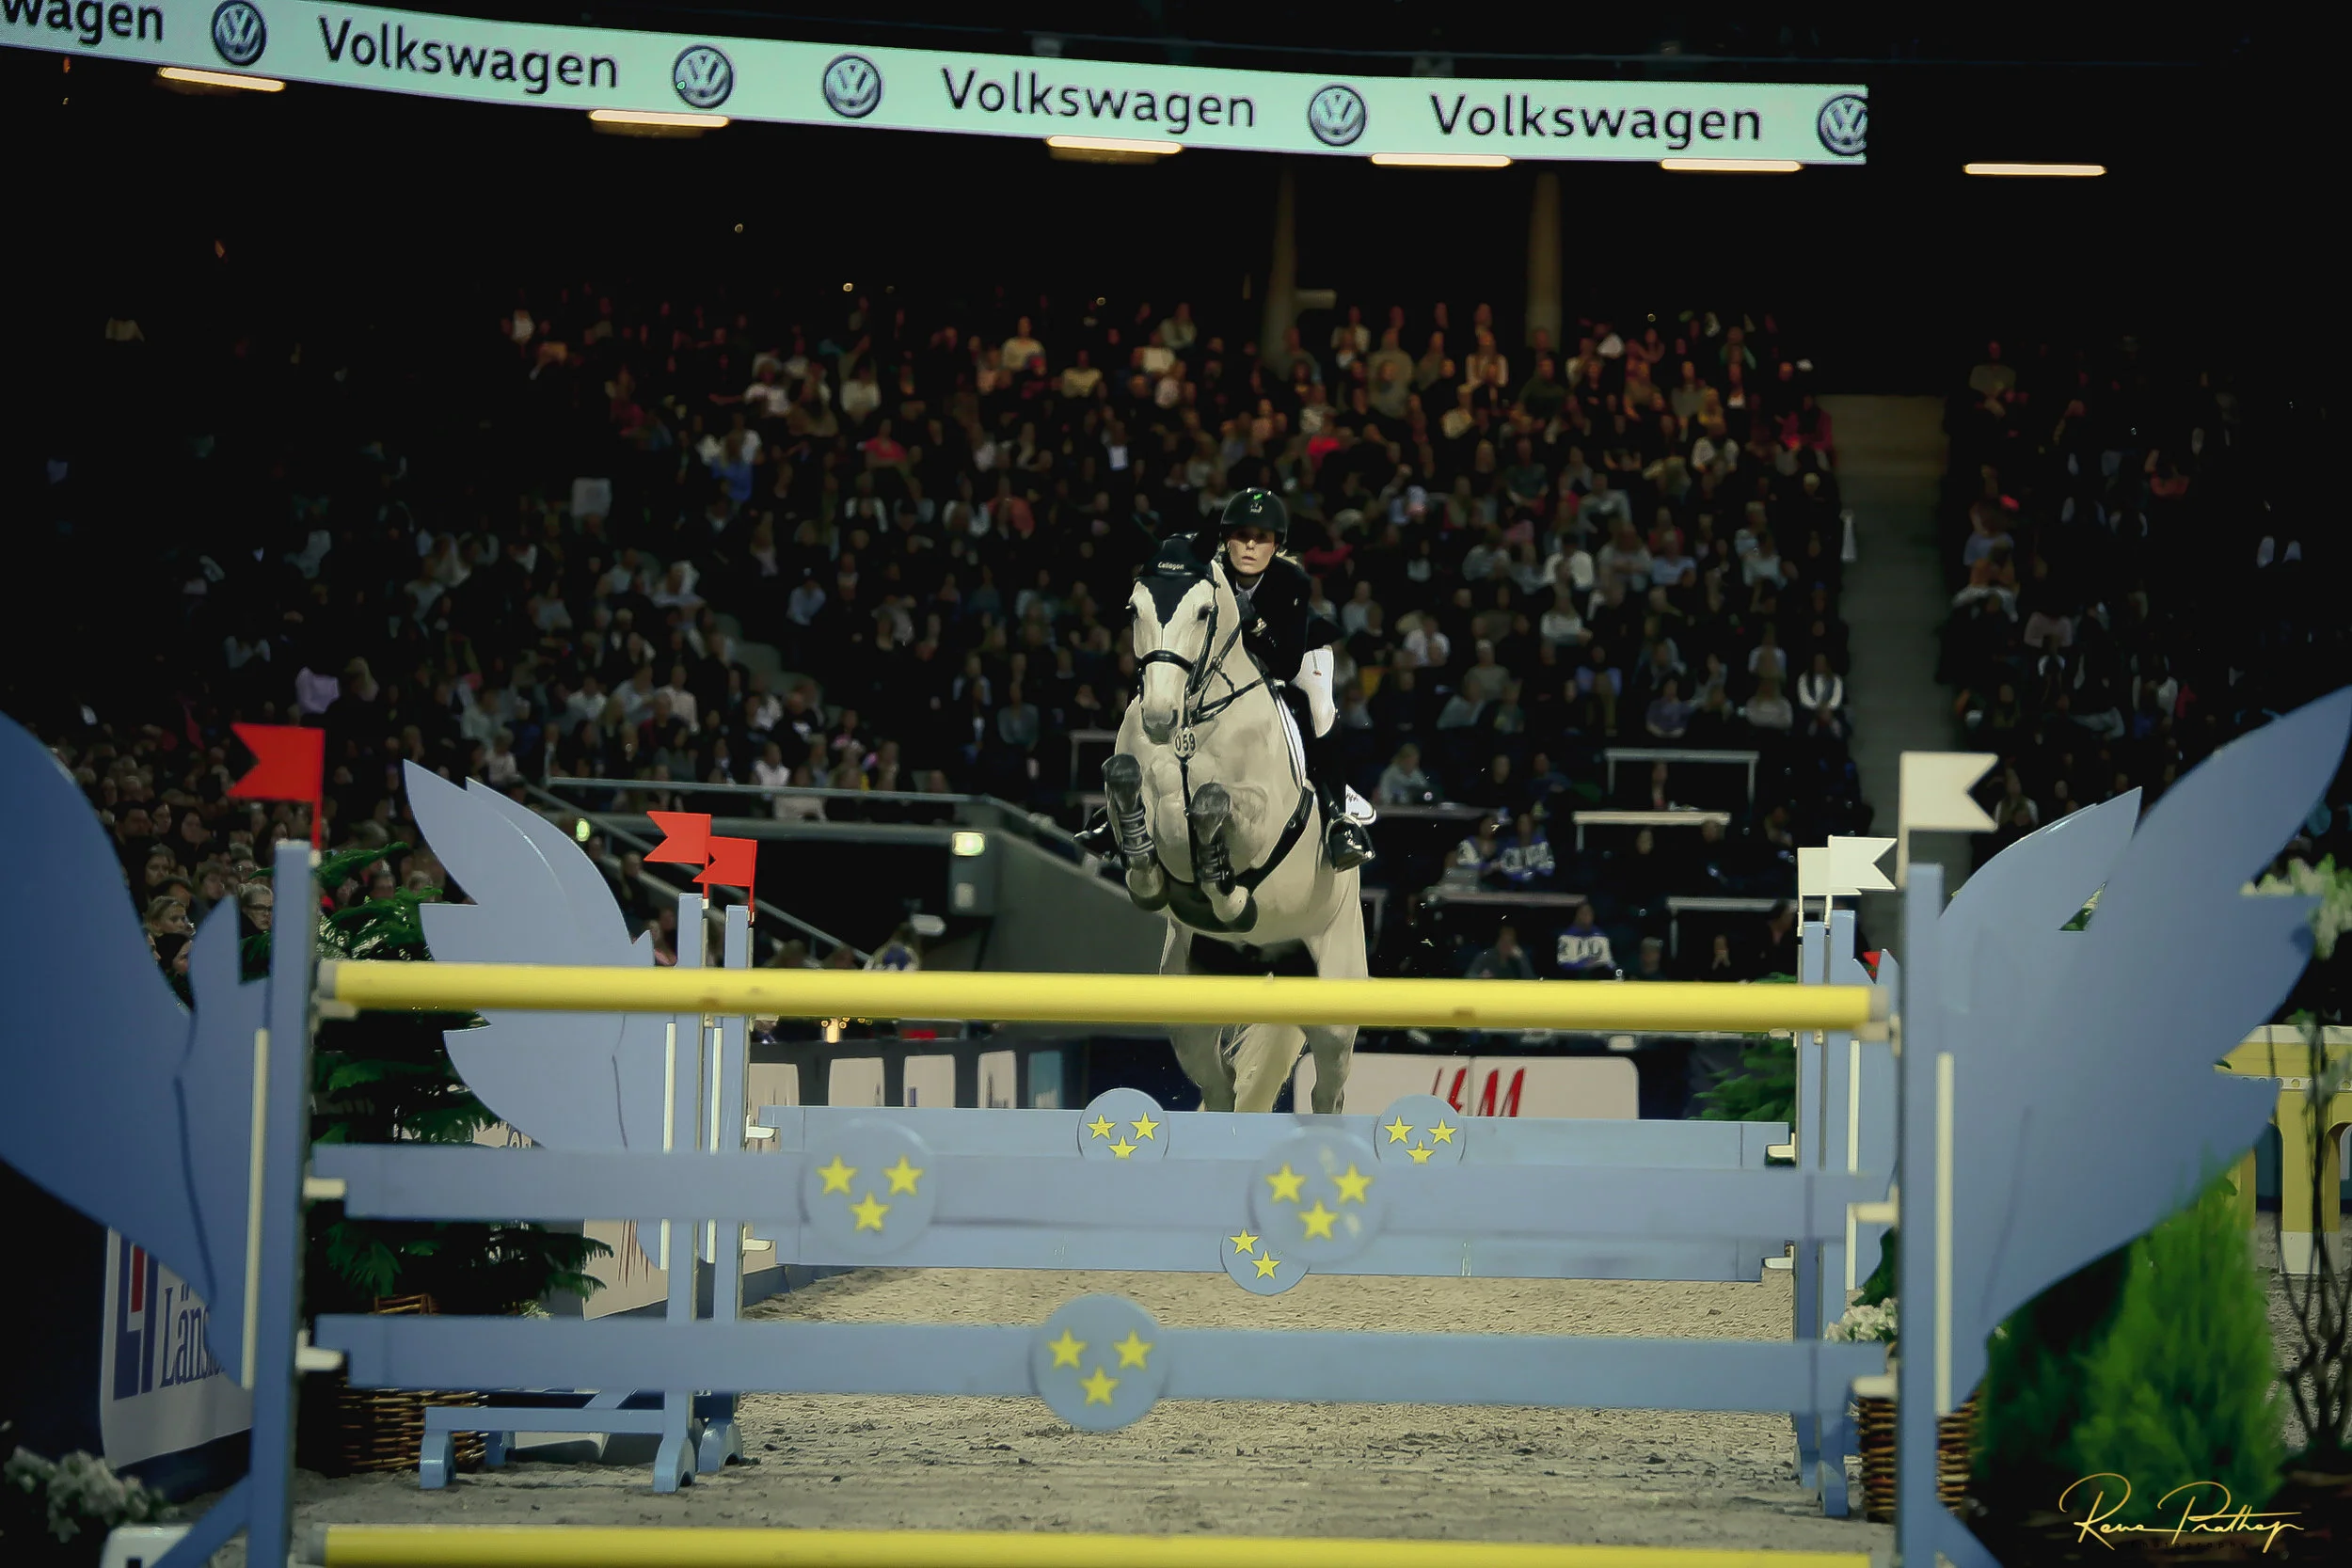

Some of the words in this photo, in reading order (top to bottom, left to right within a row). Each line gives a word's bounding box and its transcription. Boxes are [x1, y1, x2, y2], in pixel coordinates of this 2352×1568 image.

[319, 17, 617, 94] Volkswagen
[943, 69, 1253, 134] Volkswagen
[1431, 94, 1761, 150] Volkswagen
[1175, 733, 1196, 752] 059
